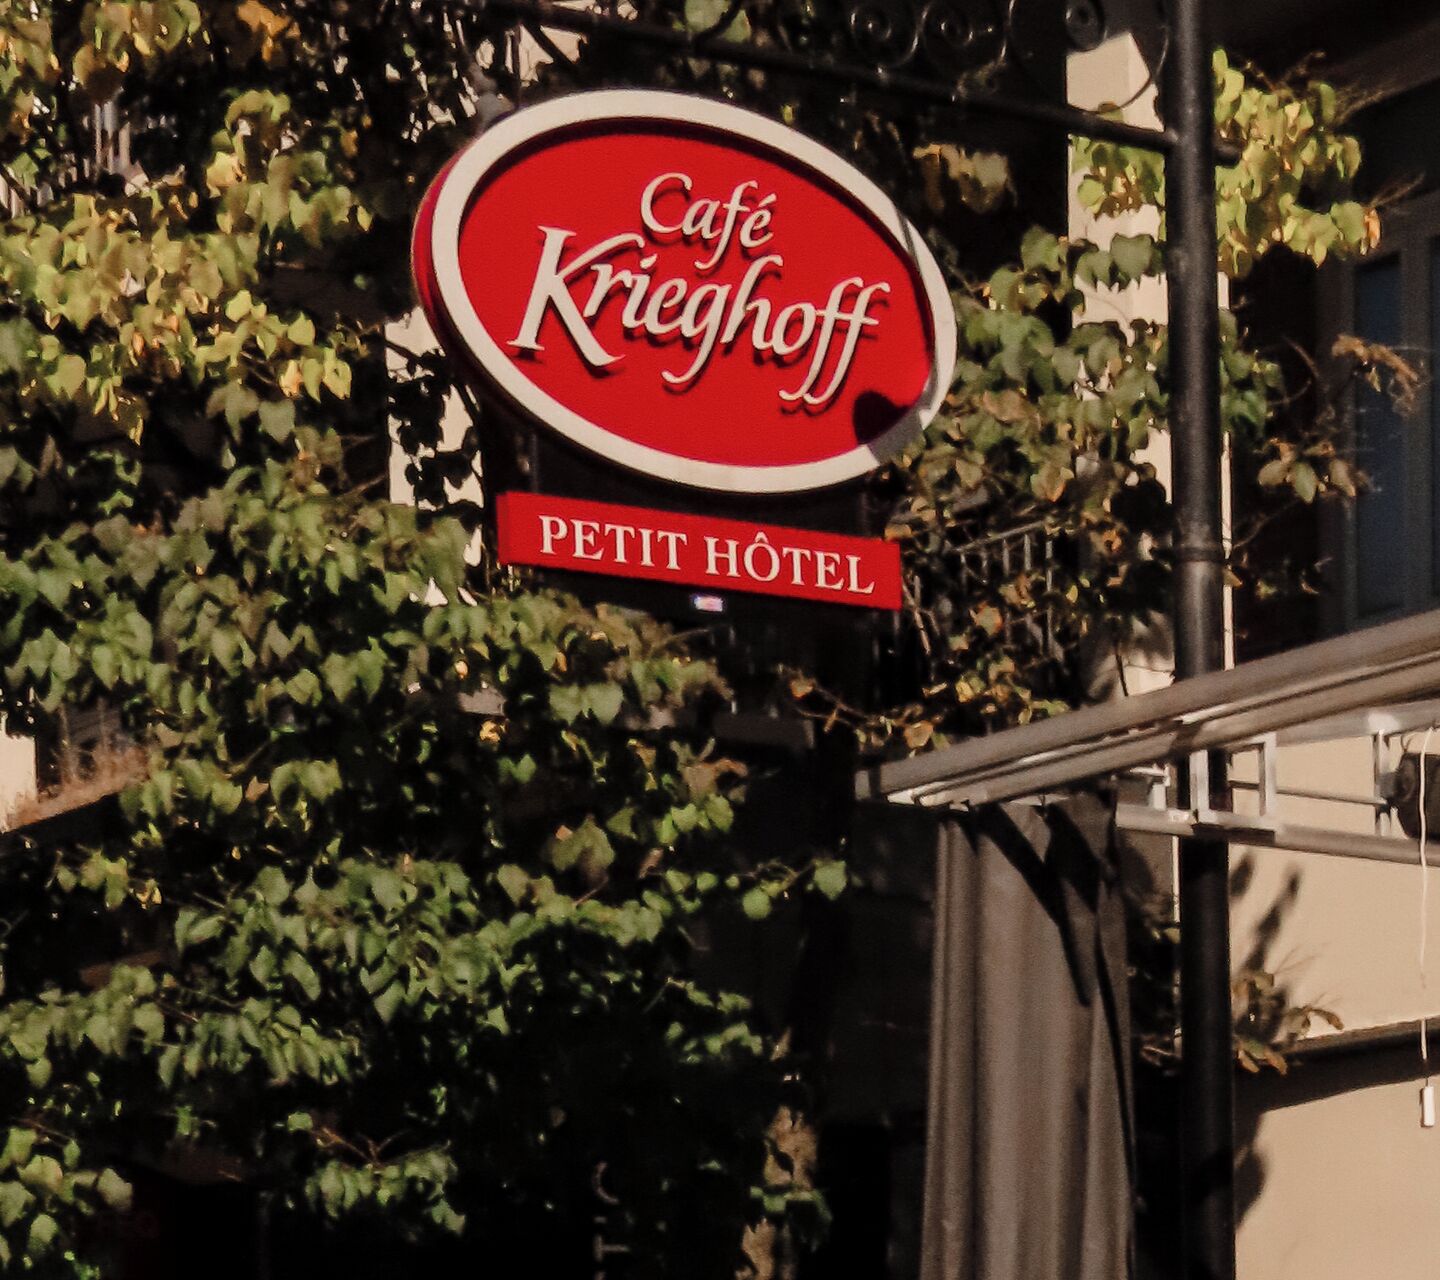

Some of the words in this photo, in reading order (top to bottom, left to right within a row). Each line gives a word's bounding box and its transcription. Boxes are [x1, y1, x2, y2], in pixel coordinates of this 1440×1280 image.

[640, 172, 776, 269] Café
[507, 224, 891, 405] Krieghoff
[539, 515, 688, 571] PETIT
[705, 532, 876, 595] HÔTEL
